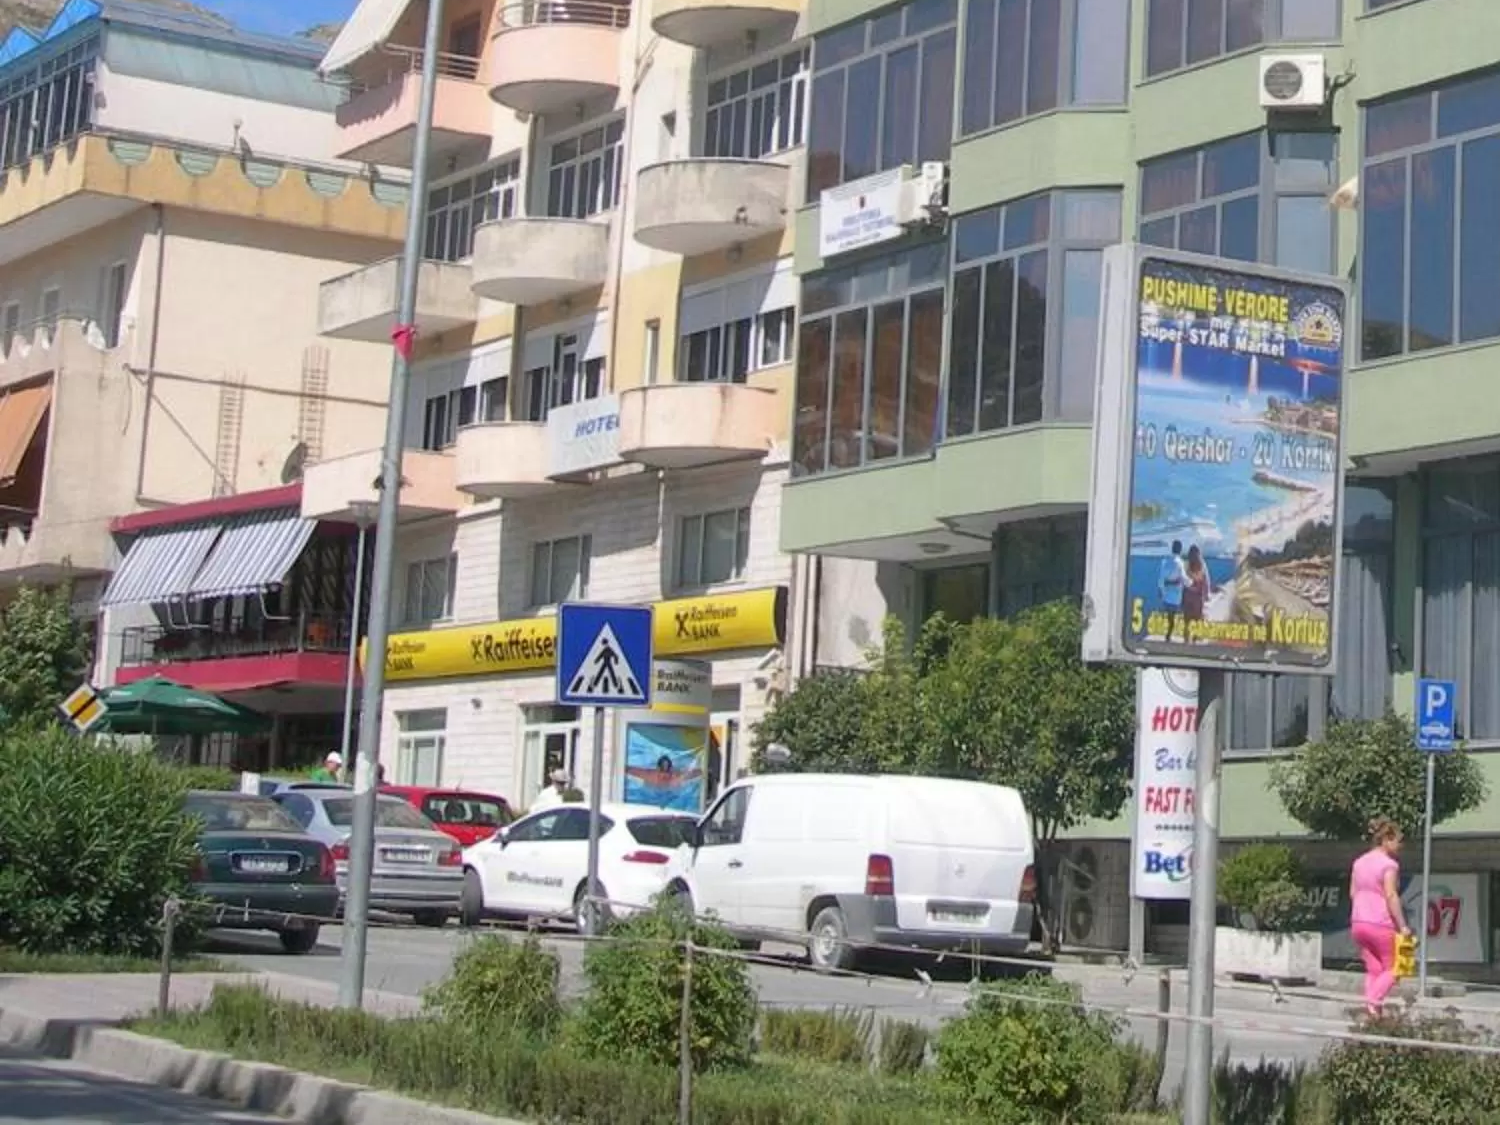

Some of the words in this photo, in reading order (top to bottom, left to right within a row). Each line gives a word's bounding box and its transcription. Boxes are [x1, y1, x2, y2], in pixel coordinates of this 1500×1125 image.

[1143, 277, 1218, 312] PUSHIME
[1190, 327, 1229, 348] STAR
[1235, 335, 1286, 358] Market
[1164, 425, 1233, 463] Qershor
[1252, 432, 1275, 466] 20
[1131, 598, 1144, 634] 5
[484, 628, 557, 663] Raiffeise
[1426, 684, 1447, 718] P
[1145, 786, 1180, 813] FAST
